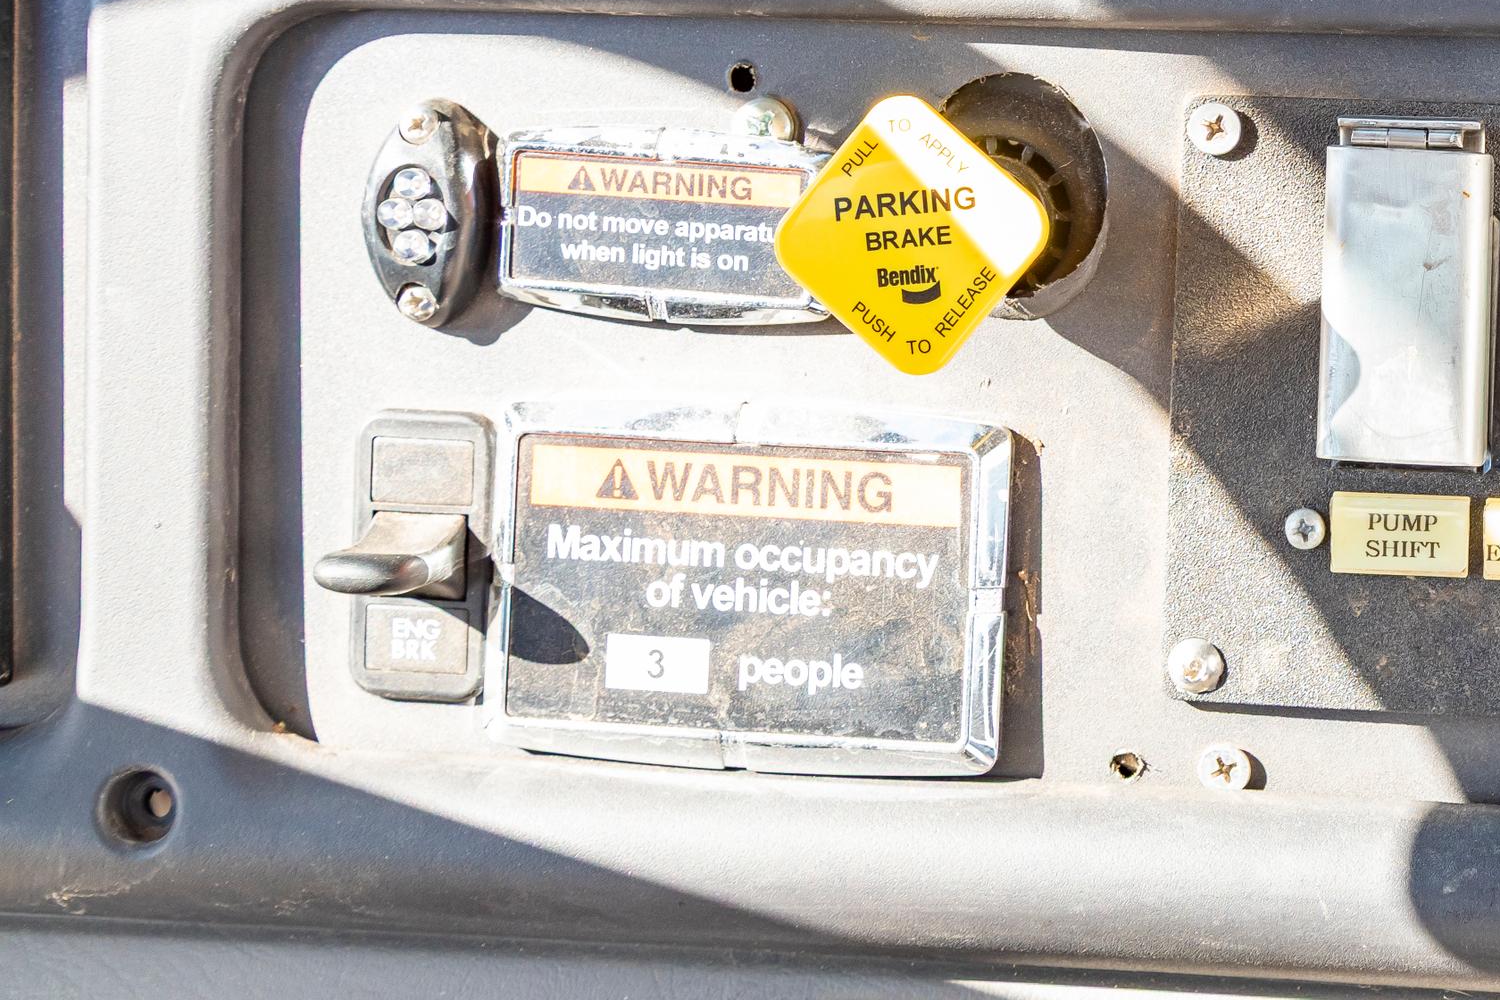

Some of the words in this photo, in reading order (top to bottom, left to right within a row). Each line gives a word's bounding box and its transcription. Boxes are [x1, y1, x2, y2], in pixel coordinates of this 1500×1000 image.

[841, 138, 879, 178] PULL
[888, 118, 911, 133] TO
[919, 133, 969, 174] APPLY
[600, 167, 753, 200] WARNING
[834, 186, 976, 222] PARKING
[517, 205, 552, 228] Do
[558, 209, 599, 232] not
[602, 212, 670, 236] move
[674, 221, 776, 244] apparatu
[865, 225, 952, 252] BRAKE
[561, 241, 625, 263] when
[631, 242, 686, 271] light
[691, 247, 711, 264] is
[716, 252, 749, 272] on
[877, 265, 937, 288] Bendix
[851, 301, 896, 342] PUSH
[906, 339, 931, 355] TO
[934, 266, 997, 338] RELEASE
[647, 461, 893, 513] WARNING
[1368, 513, 1438, 532] PUMP
[546, 523, 726, 568] Maximum
[733, 541, 940, 588] occupancy
[1365, 540, 1440, 559] SHIFT
[645, 573, 687, 609] of
[690, 577, 833, 617] vehicle:
[391, 617, 442, 640] ENG
[391, 638, 437, 660] BRK
[646, 649, 666, 680] 3
[737, 653, 865, 695] people
